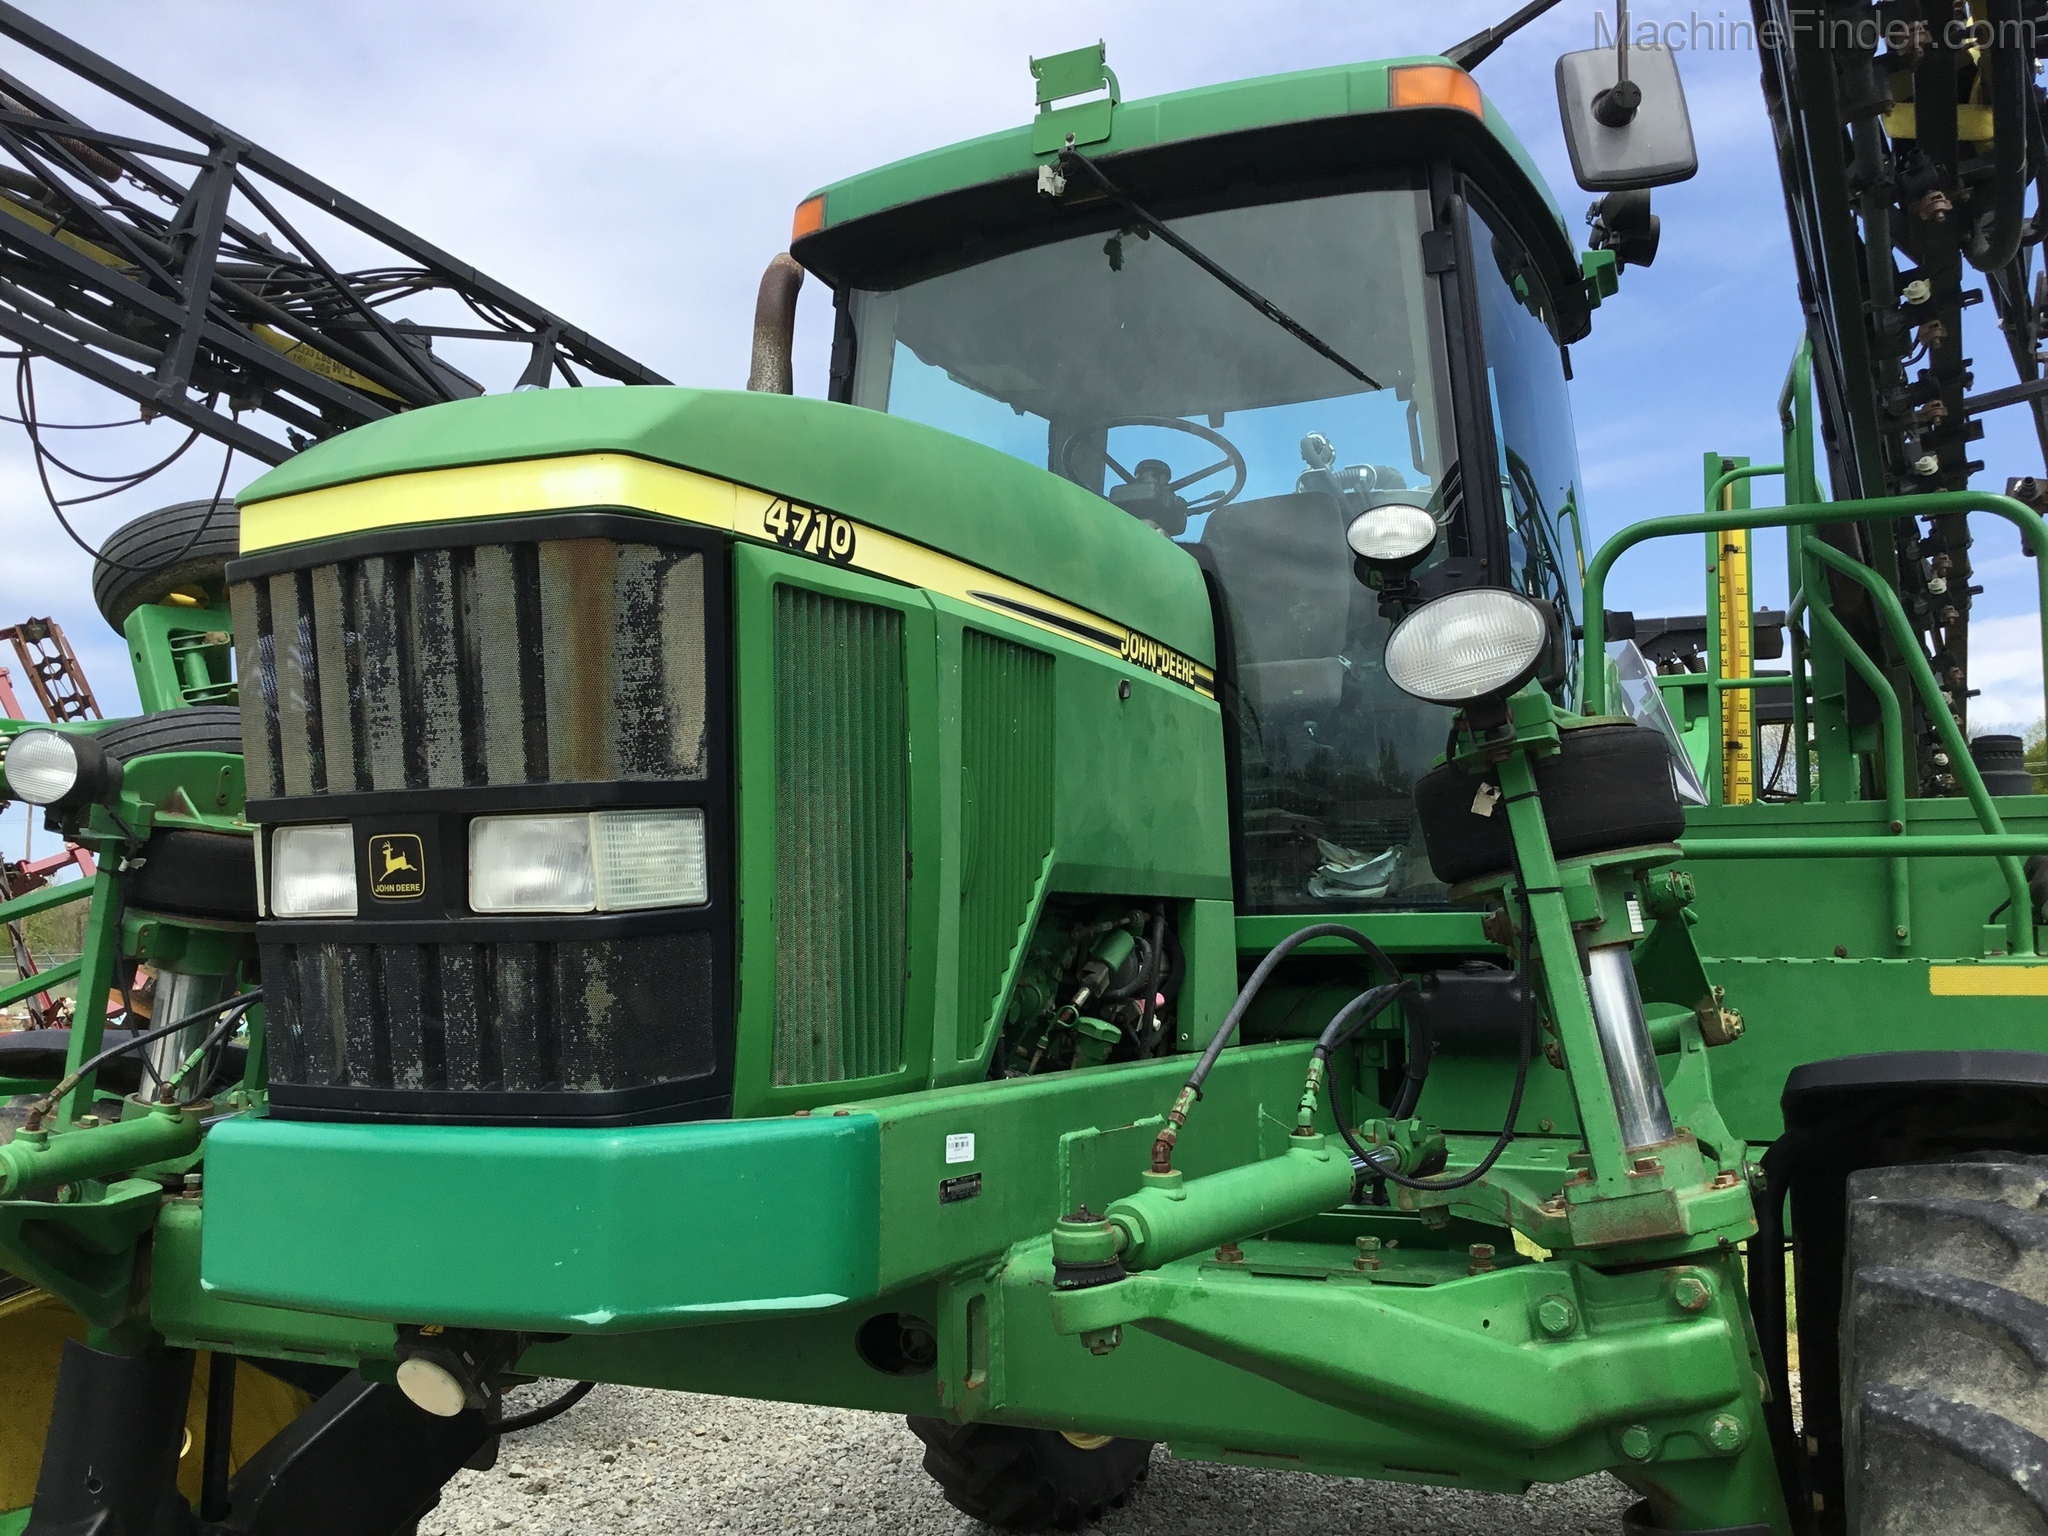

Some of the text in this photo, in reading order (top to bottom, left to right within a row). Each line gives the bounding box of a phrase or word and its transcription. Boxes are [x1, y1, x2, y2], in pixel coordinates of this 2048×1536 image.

[764, 498, 855, 561] 4710
[1121, 629, 1195, 686] JOHN DEERE
[375, 883, 421, 893] JOHN DEERE
